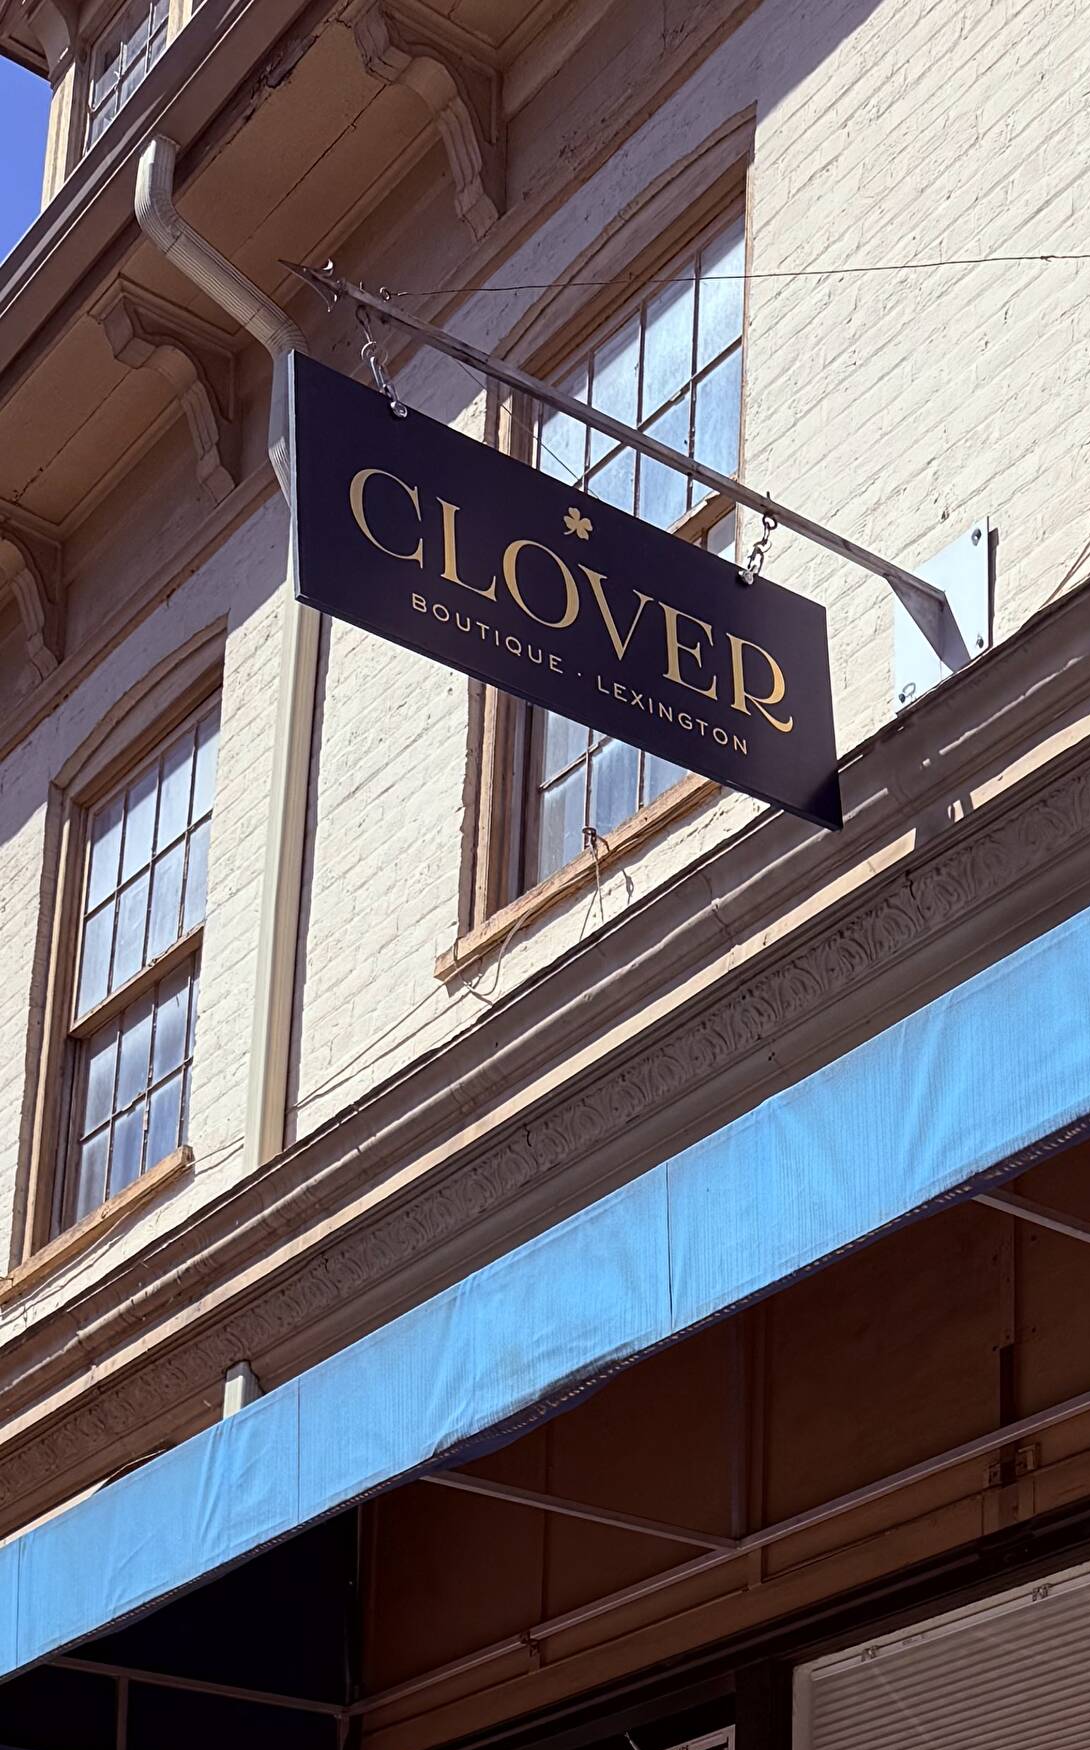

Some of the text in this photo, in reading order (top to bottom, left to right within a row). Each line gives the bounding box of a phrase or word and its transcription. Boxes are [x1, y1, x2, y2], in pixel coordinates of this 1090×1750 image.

[349, 468, 794, 733] CLOVER
[411, 592, 748, 756] BOUTIQUE LEXINGTON
